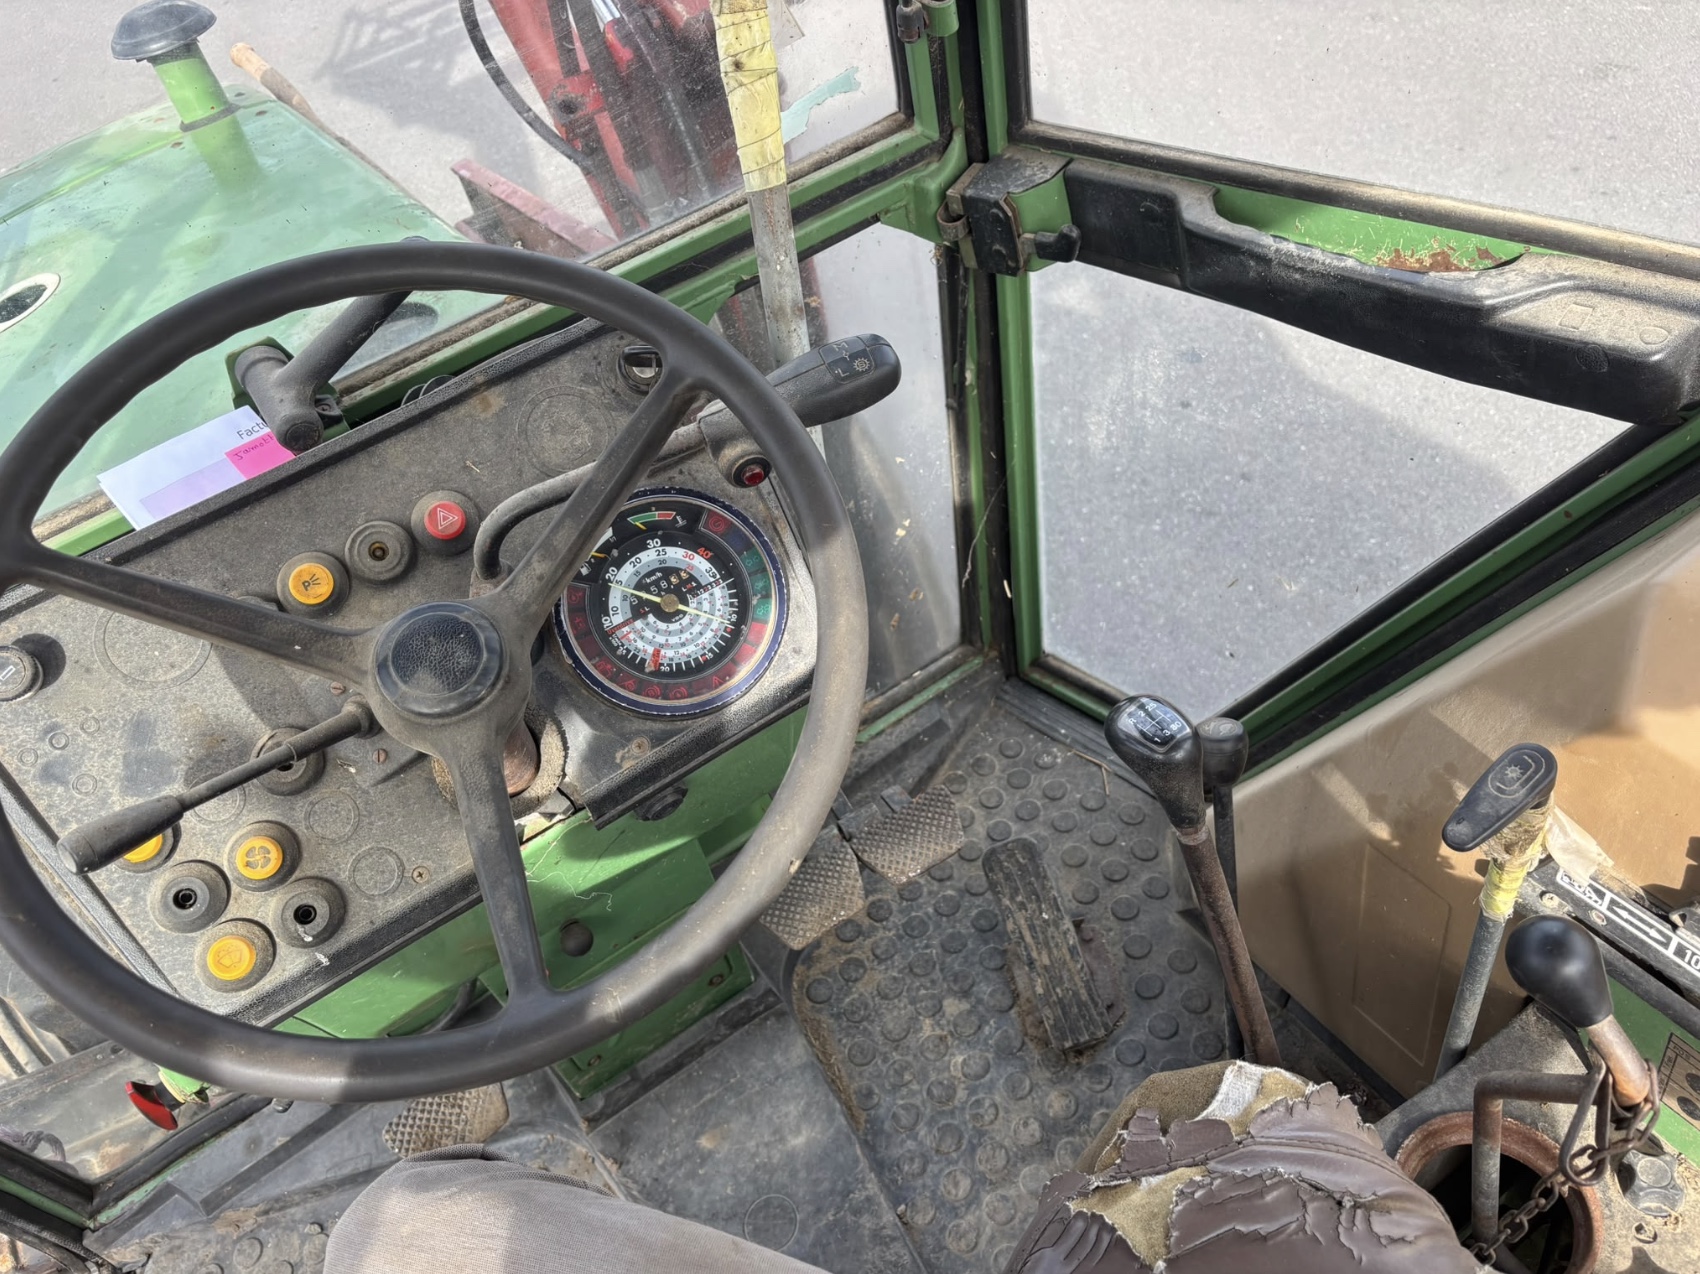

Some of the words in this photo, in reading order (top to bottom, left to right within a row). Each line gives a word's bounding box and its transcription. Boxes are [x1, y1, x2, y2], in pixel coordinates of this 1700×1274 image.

[236, 421, 269, 440] Factu
[646, 538, 661, 548] 30
[655, 548, 667, 557] 25
[682, 551, 695, 561] 30
[697, 547, 712, 559] 40
[629, 557, 642, 569] 20
[605, 567, 618, 581] 20
[633, 570, 641, 578] 15
[645, 571, 663, 583] km/h
[705, 567, 718, 579] 35
[302, 580, 311, 592] P
[622, 594, 629, 602] 10
[611, 606, 620, 617] 10
[602, 616, 613, 628] 10
[731, 614, 738, 622] 10
[705, 652, 713, 660] 15
[1128, 717, 1137, 725] R
[1145, 702, 1157, 711] 25
